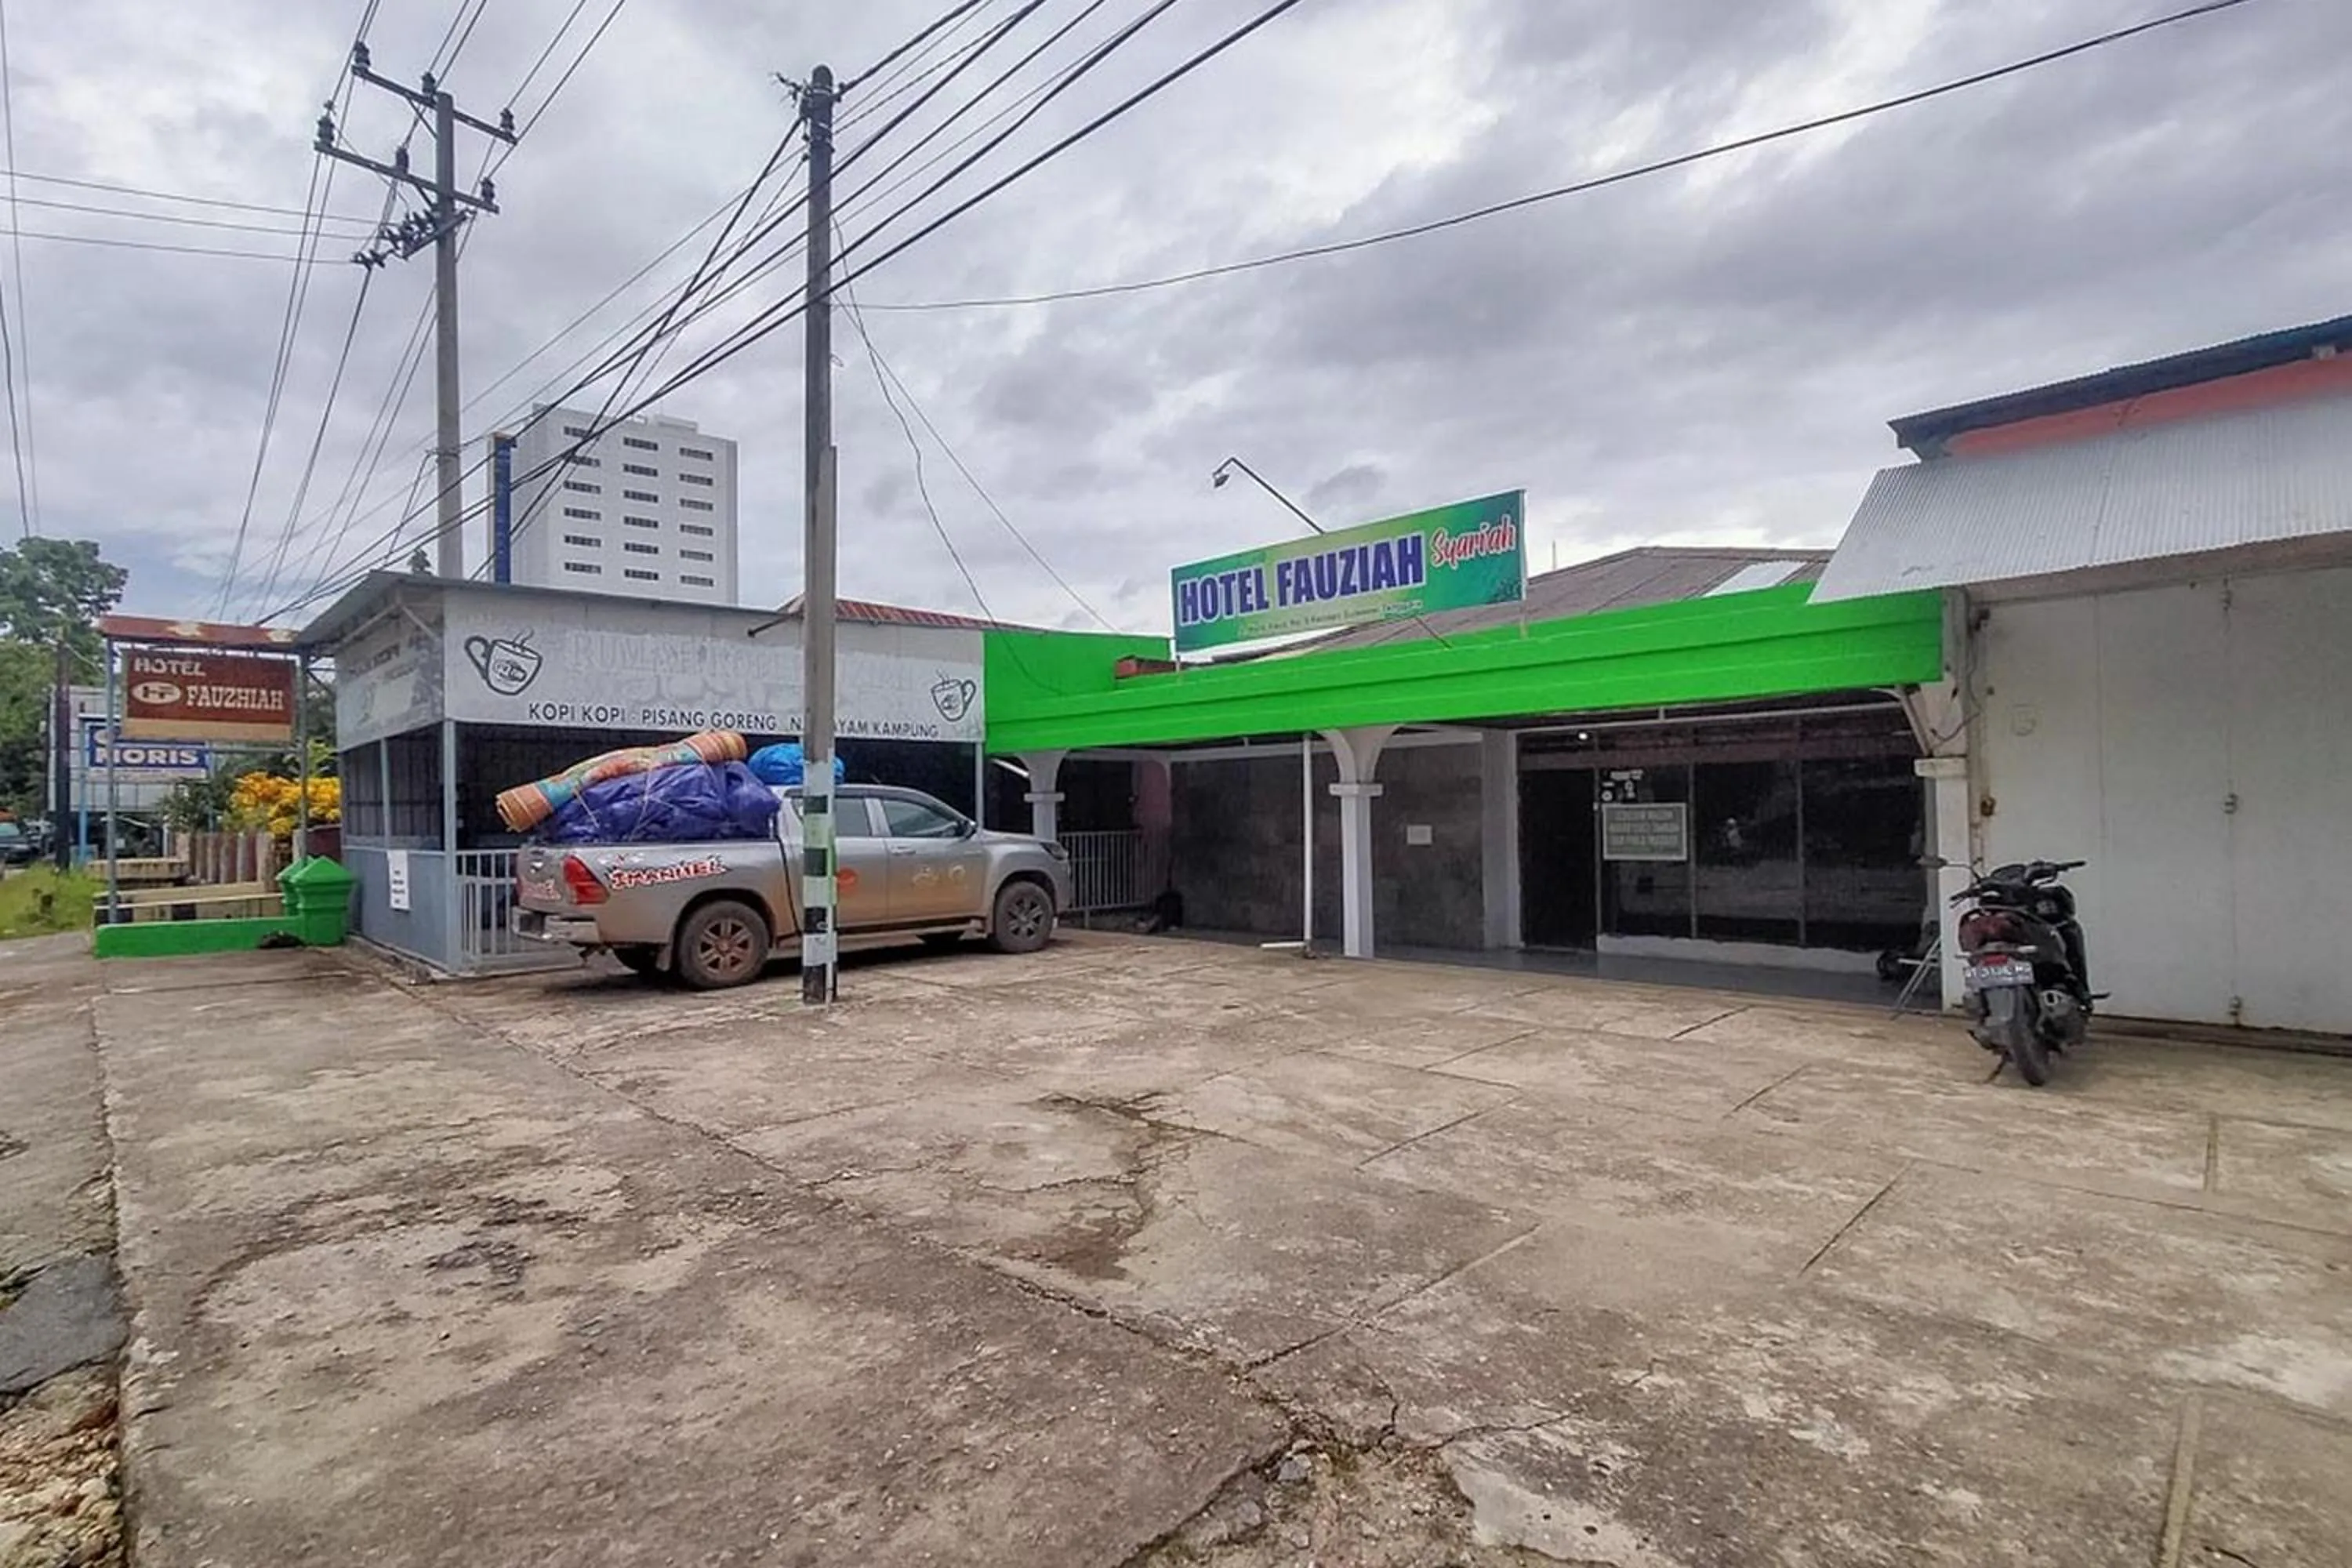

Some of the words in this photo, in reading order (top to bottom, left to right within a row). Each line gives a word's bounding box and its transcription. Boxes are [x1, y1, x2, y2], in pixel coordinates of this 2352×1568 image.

[1431, 516, 1516, 568] Syariah
[1180, 566, 1270, 624] HOTEL
[1276, 534, 1424, 608] FAUZIAH
[133, 658, 206, 677] HOTEL
[186, 685, 284, 710] FAUZHIAH
[528, 702, 575, 721] KOPI
[583, 705, 626, 723] KOPI
[641, 709, 705, 728] PISANG
[710, 711, 776, 731] GORENG
[833, 717, 868, 735] YAM
[873, 720, 939, 738] KAMPUNG
